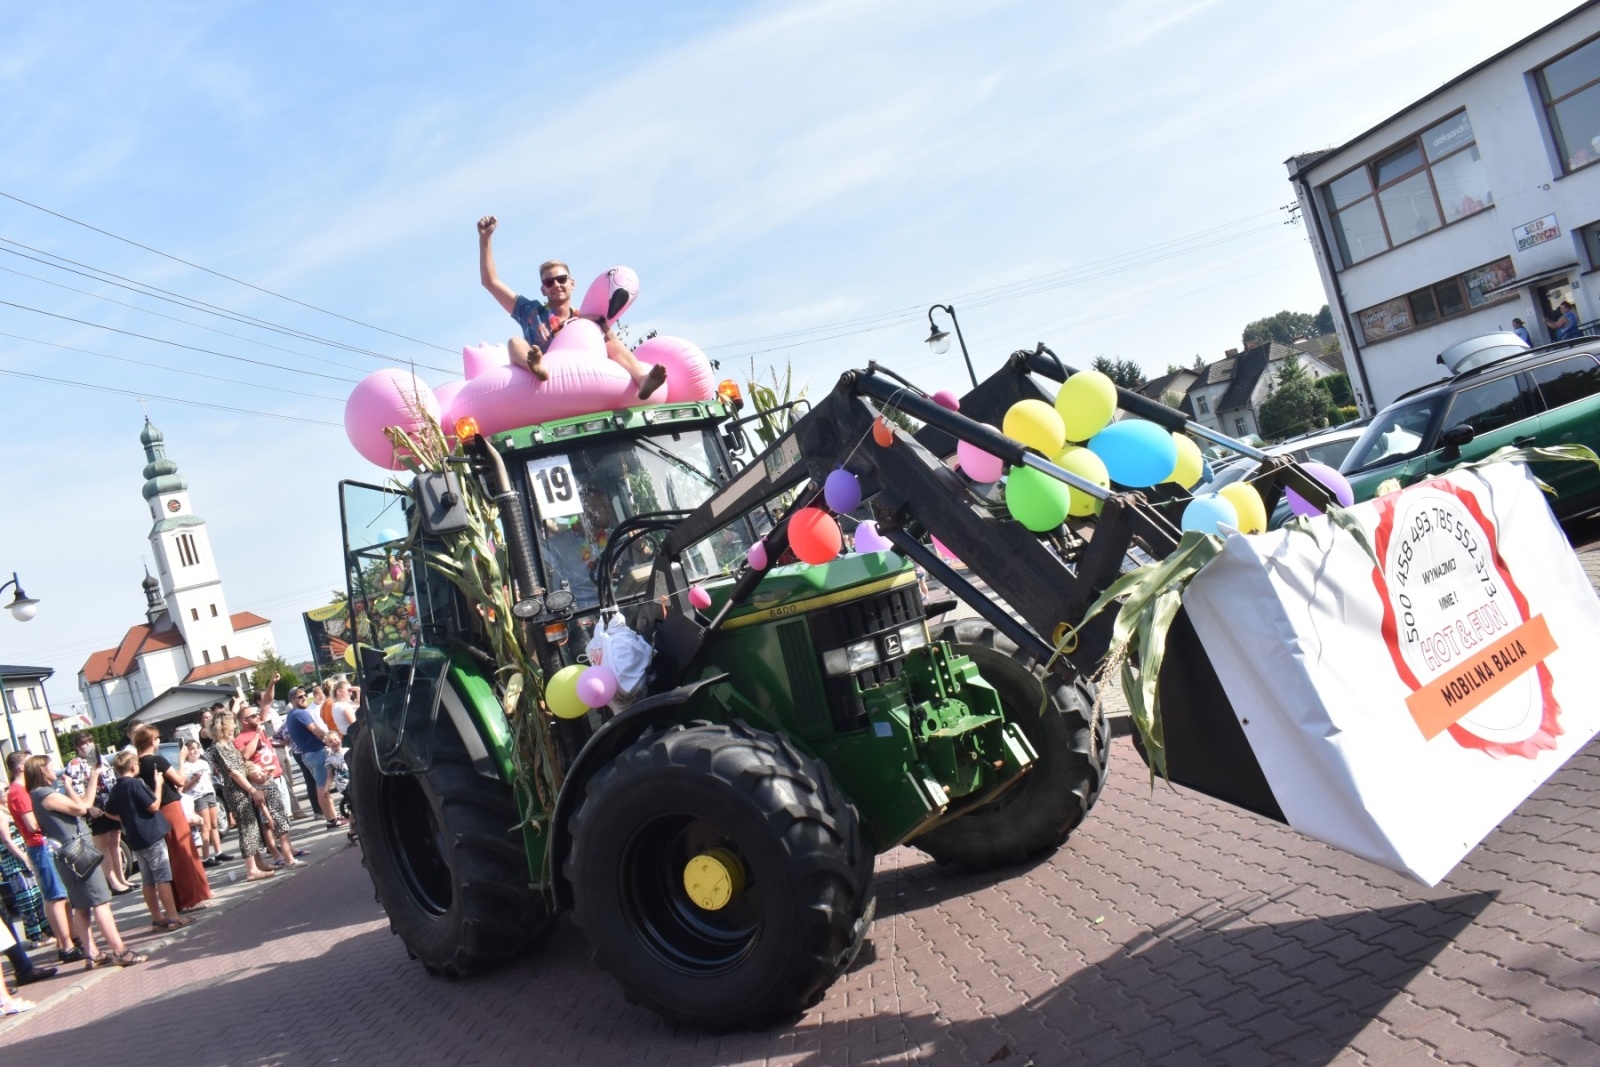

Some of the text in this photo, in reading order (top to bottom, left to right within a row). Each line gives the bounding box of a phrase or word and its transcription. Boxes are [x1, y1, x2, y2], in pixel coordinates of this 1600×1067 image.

[535, 466, 573, 504] 19
[1455, 520, 1478, 560] 552
[1396, 540, 1413, 587] 458
[1475, 555, 1497, 598] 373
[769, 604, 797, 617] 6400
[1399, 593, 1420, 643] 500
[1420, 625, 1461, 671] HOT
[1466, 600, 1508, 642] FUN
[1440, 639, 1527, 707] MOBILNA BALIA
